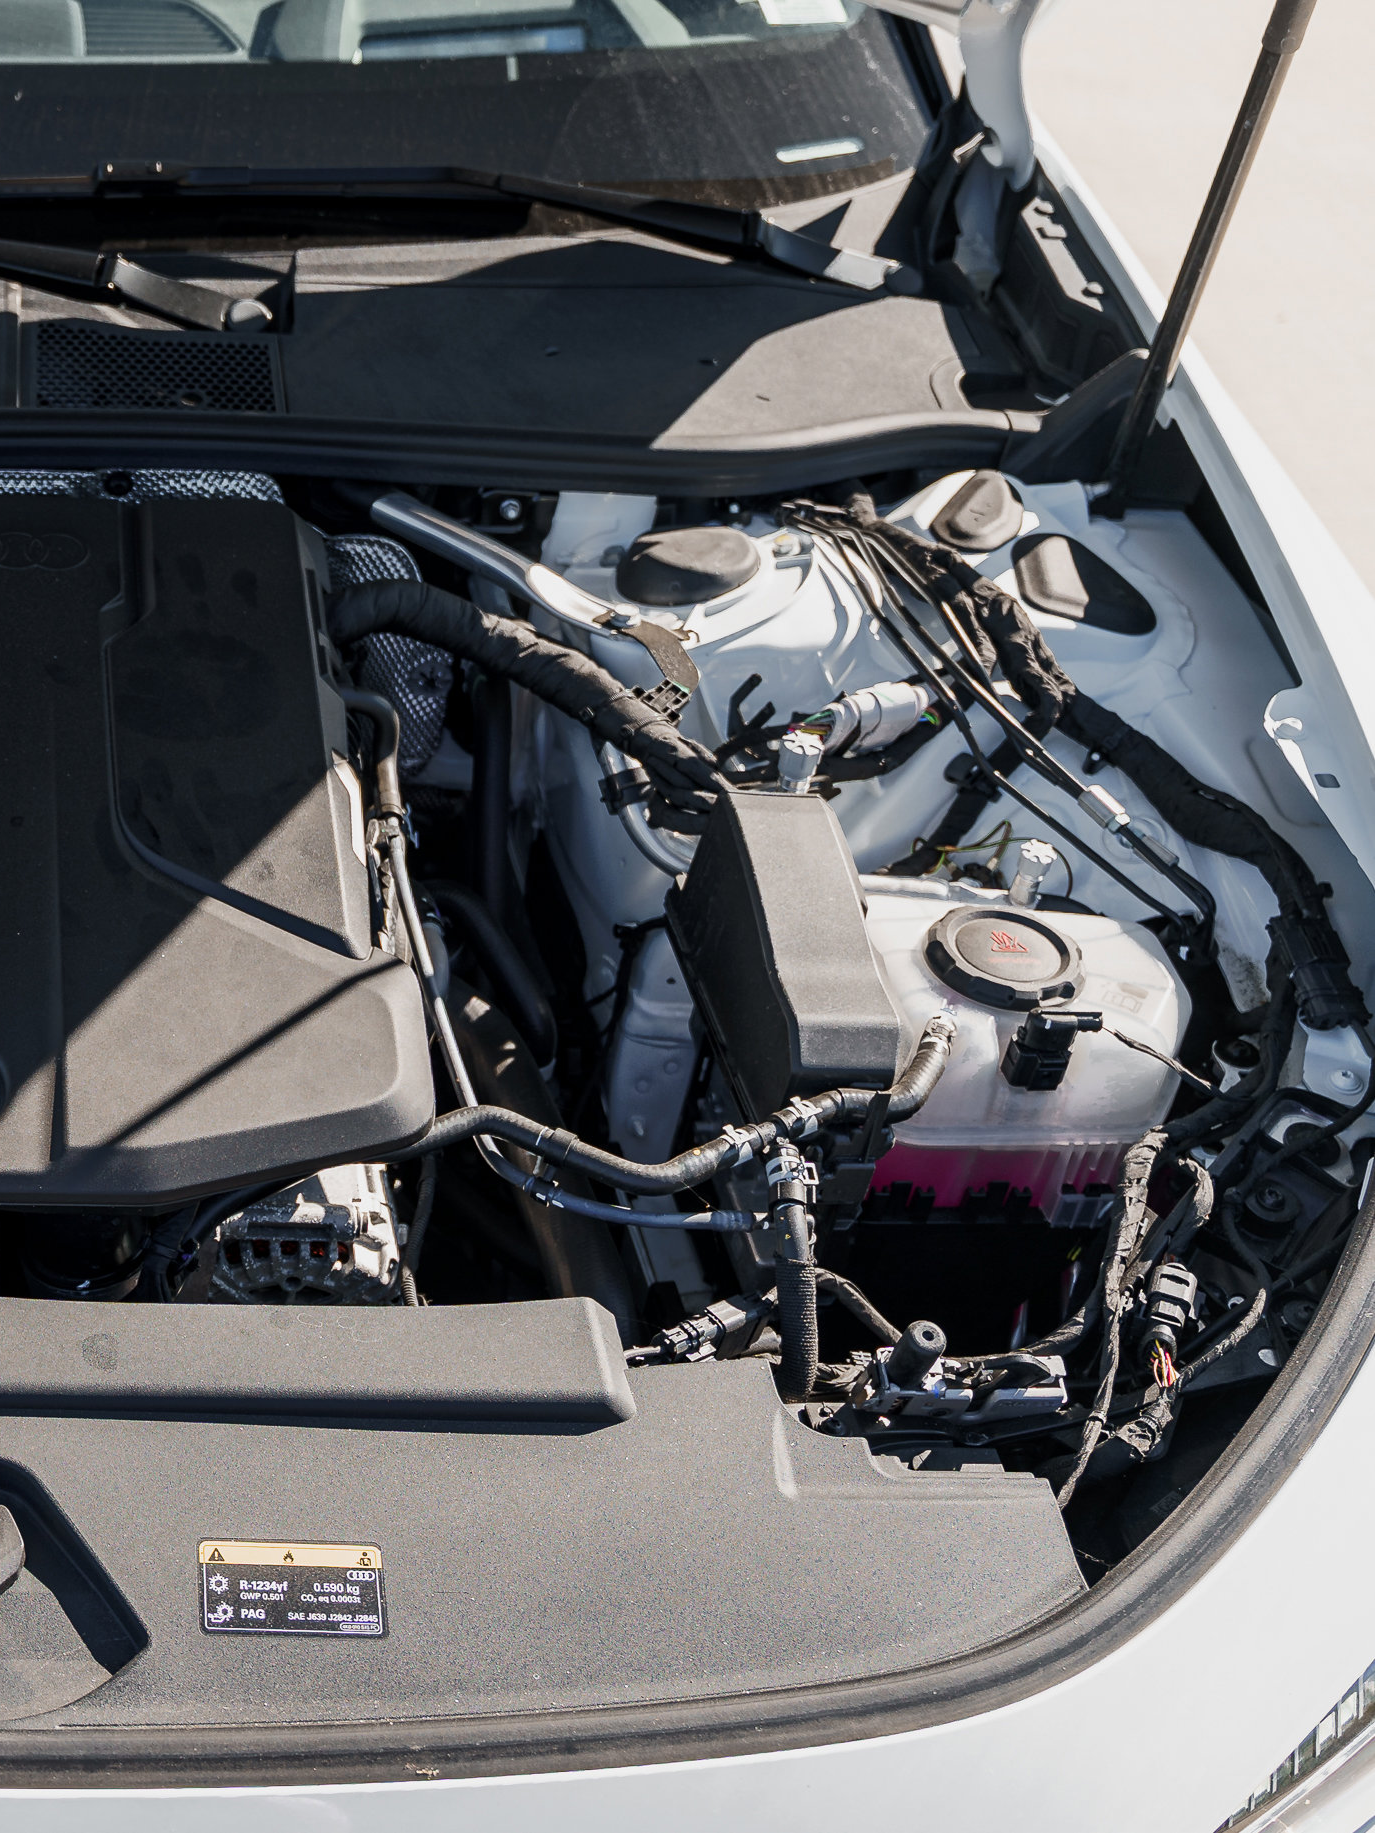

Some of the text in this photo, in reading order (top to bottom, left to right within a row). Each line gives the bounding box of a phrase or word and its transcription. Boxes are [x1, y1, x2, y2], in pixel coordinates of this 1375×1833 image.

[239, 1580, 288, 1593] R-1234yf
[314, 1583, 360, 1595] 0.590 kg
[262, 1593, 284, 1601] 0.501
[240, 1608, 266, 1619] PAG
